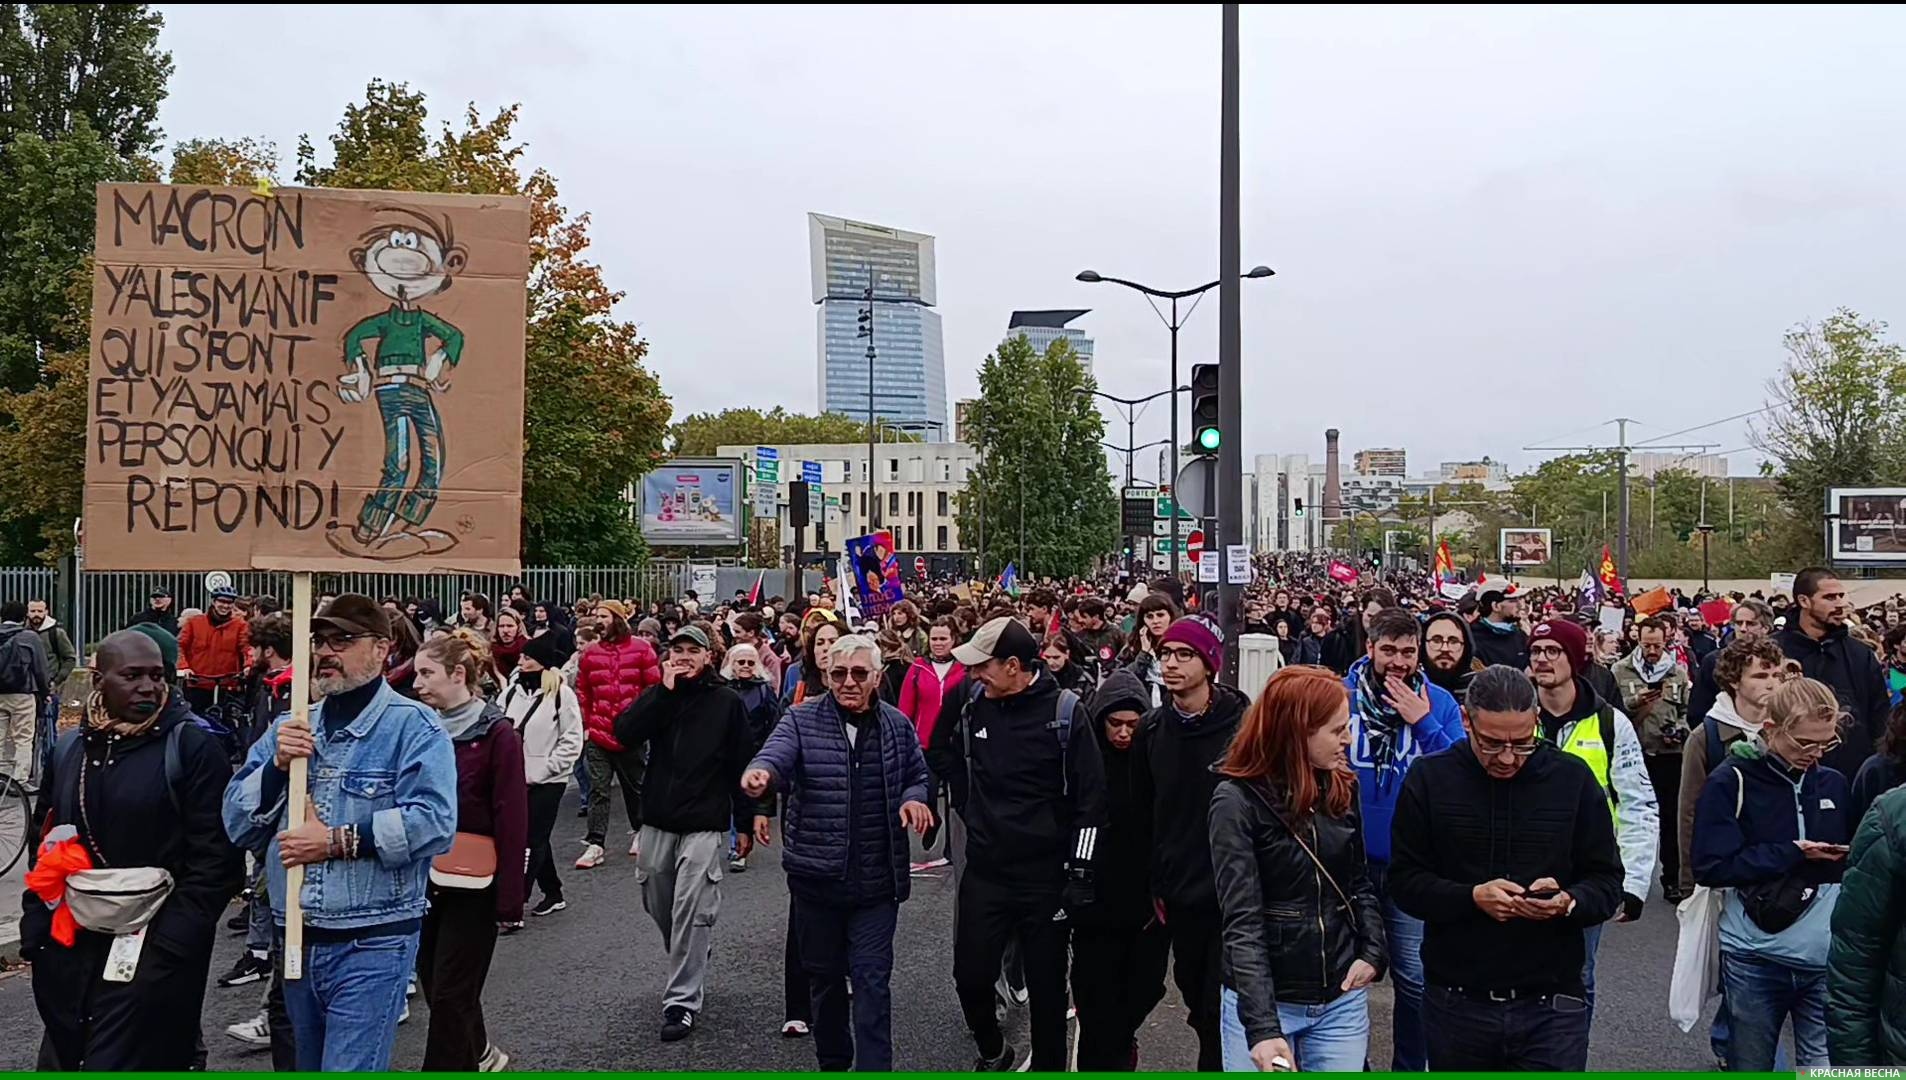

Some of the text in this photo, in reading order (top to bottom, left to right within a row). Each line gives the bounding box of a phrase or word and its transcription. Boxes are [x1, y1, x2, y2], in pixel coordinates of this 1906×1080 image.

[113, 188, 304, 254] MACRON
[153, 269, 212, 318] LES
[212, 270, 338, 329] MANIF
[101, 321, 316, 377] QUI S'FONT
[96, 377, 145, 416] ET
[199, 378, 331, 426] JAMAIS
[319, 426, 345, 470] Y
[213, 578, 224, 587] 20
